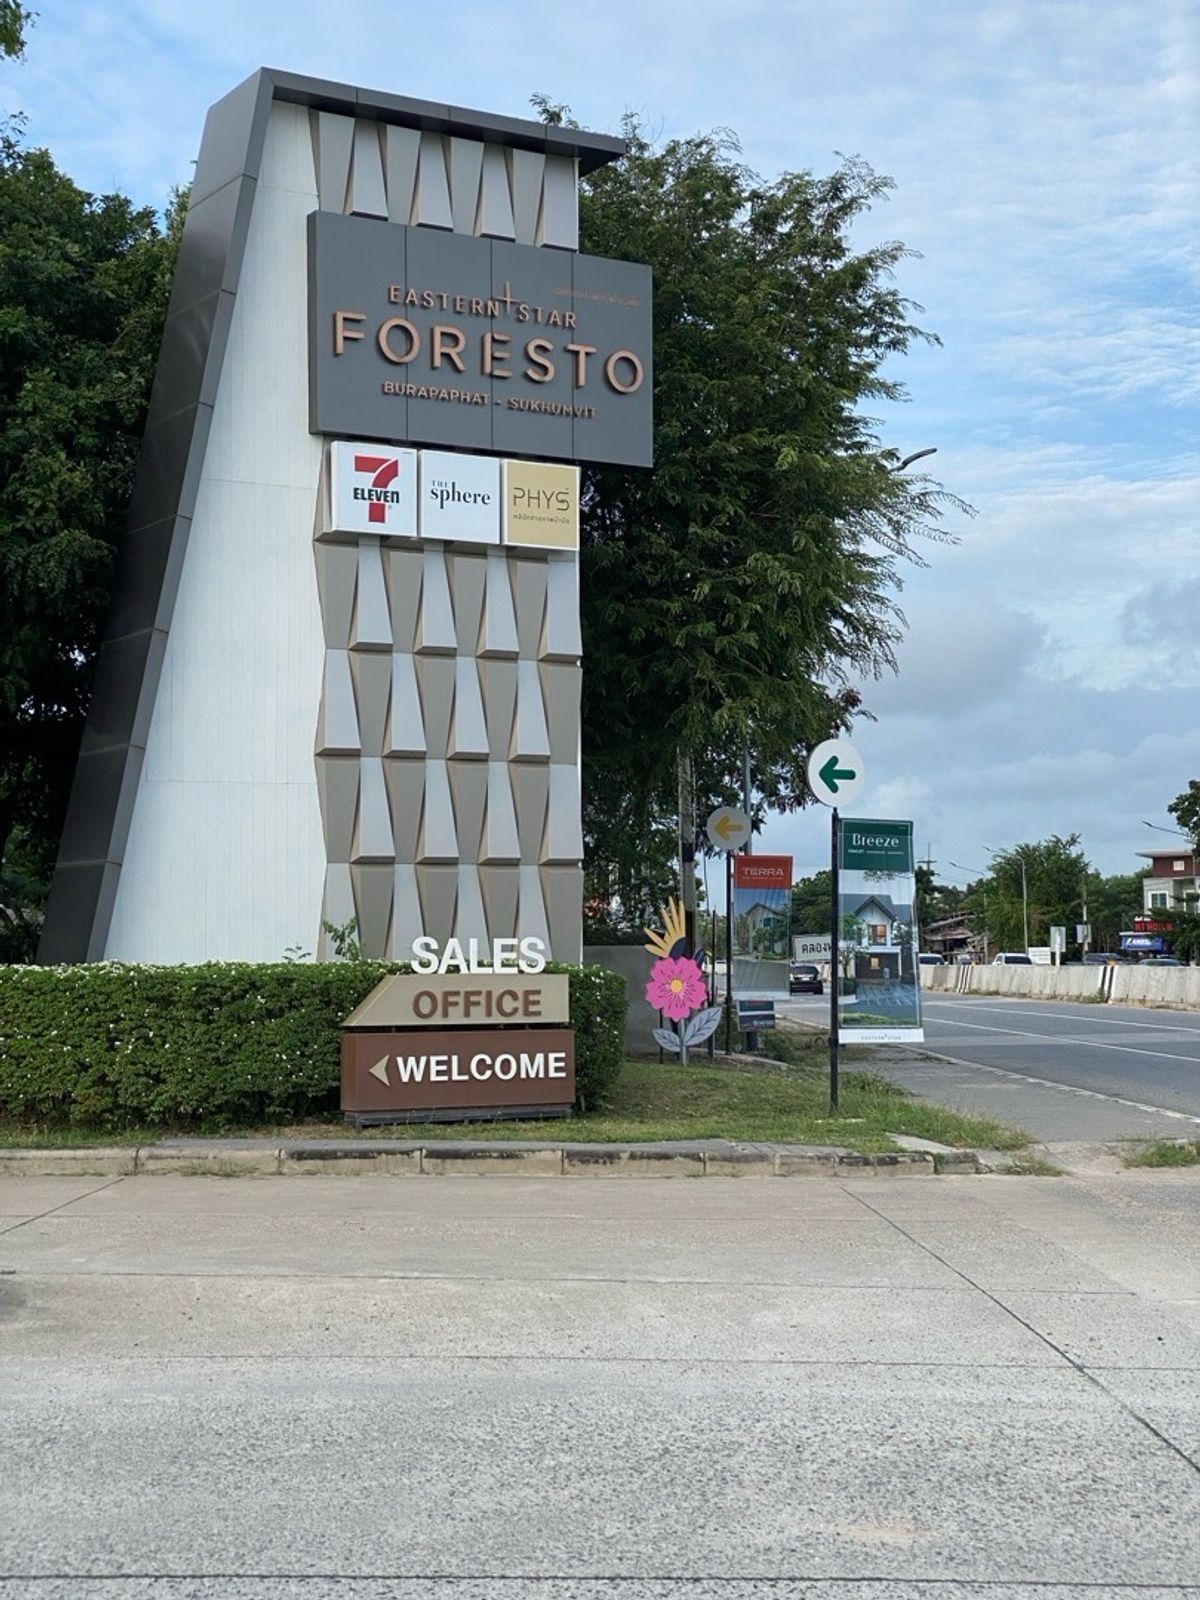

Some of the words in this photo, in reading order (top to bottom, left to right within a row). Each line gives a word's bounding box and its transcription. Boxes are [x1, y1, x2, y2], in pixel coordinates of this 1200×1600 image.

[388, 285, 500, 317] EASTERN
[518, 303, 578, 329] STAR
[334, 310, 645, 394] FORESTO
[383, 380, 490, 405] BURAPAPHAT
[508, 397, 597, 418] SUKHUMVIT
[354, 456, 399, 524] 7
[430, 481, 491, 509] sphere
[432, 480, 449, 488] THE
[513, 487, 570, 511] PHYS
[852, 833, 900, 848] Breeze
[742, 867, 785, 877] TERRA
[411, 936, 547, 975] SALES
[412, 989, 542, 1019] OFFICE
[396, 1052, 567, 1083] WELCOME
